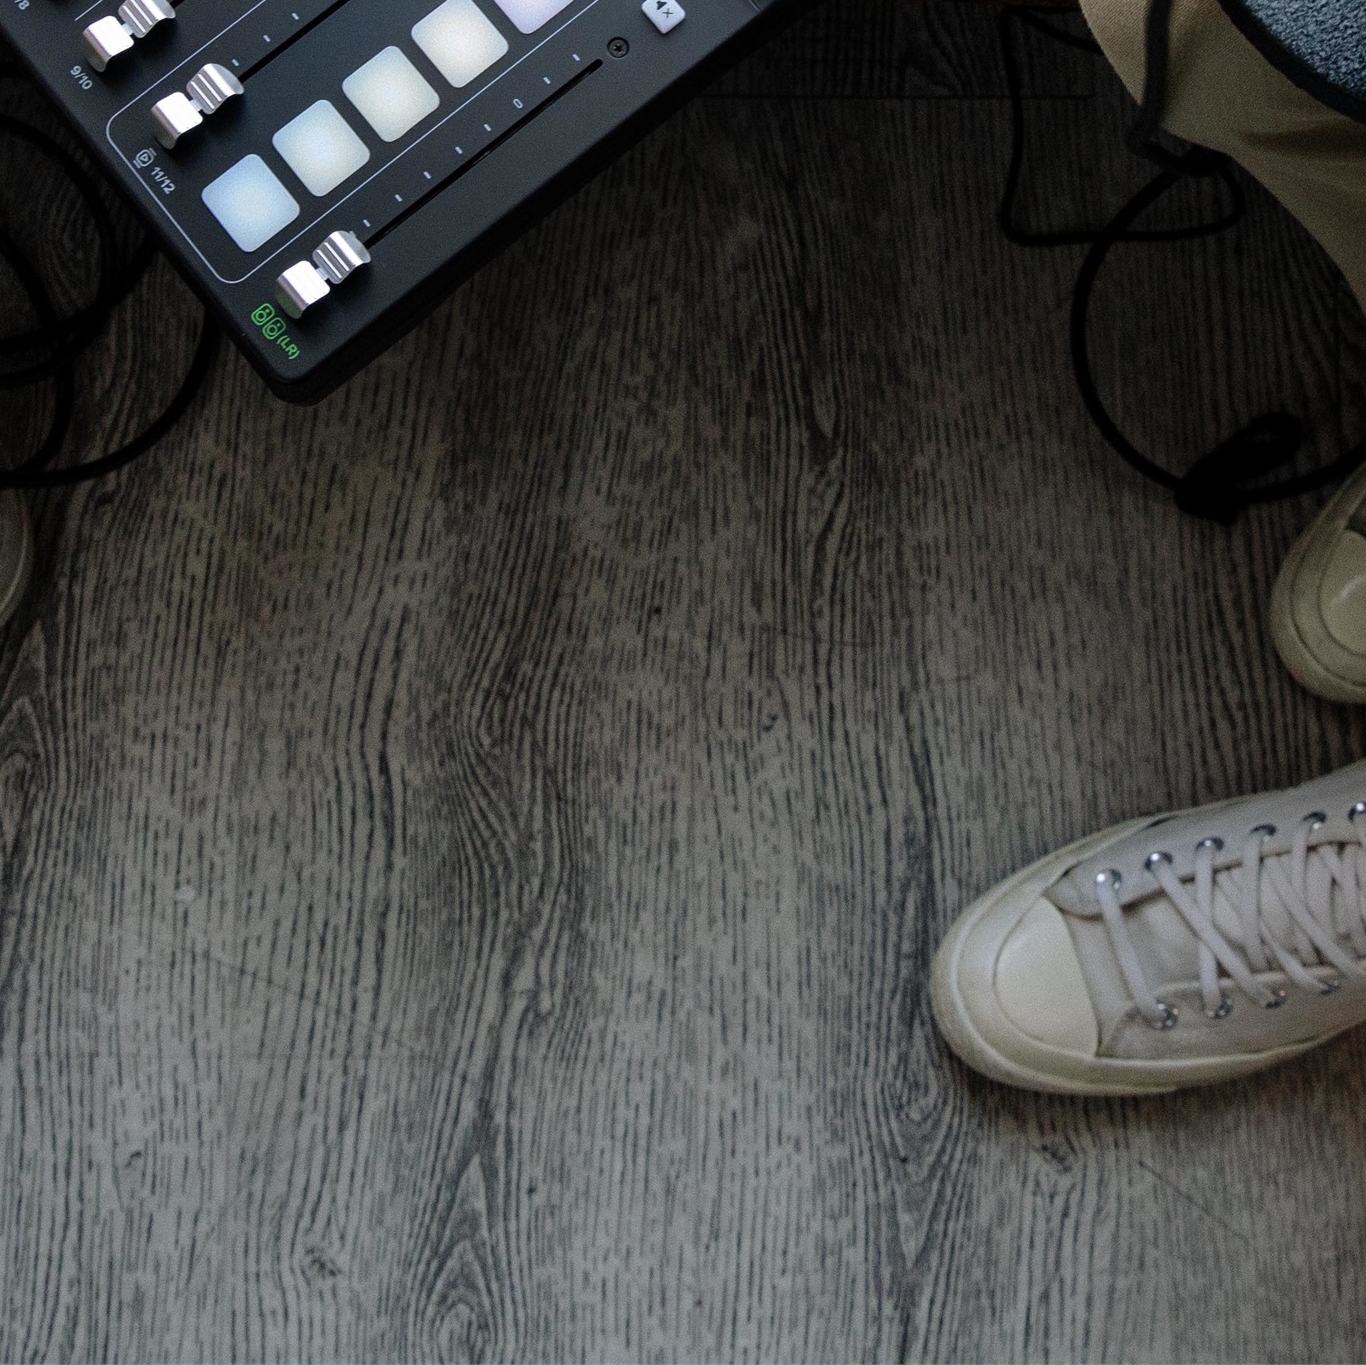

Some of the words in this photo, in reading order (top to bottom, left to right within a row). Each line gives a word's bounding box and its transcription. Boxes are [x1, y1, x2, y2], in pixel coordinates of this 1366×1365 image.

[70, 65, 93, 90] 9/10
[513, 98, 523, 108] 0
[151, 166, 176, 195] 11/12
[276, 335, 300, 360] (LR)
